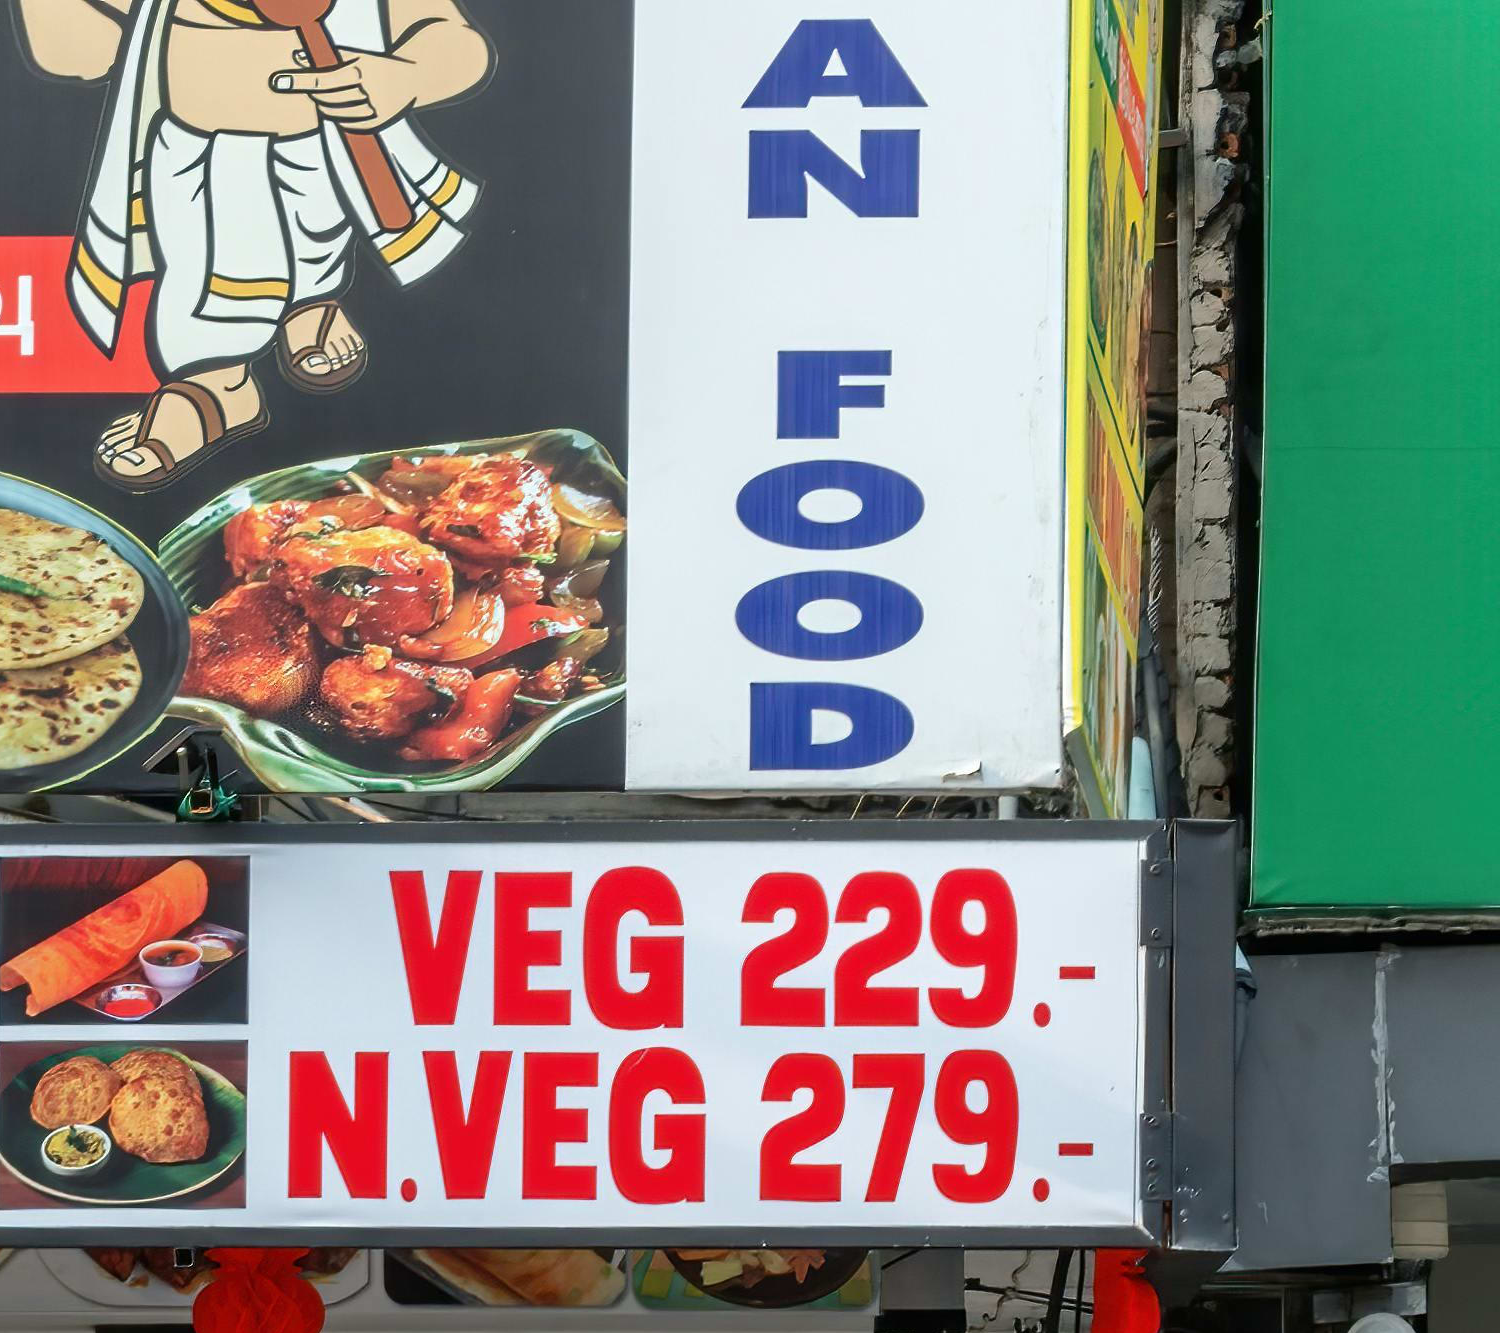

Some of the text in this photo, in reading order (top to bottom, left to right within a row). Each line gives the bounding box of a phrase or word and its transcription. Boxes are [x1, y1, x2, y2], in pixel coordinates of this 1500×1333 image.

[735, 350, 924, 772] FOOD
[388, 866, 1095, 1030] VEG 229.-
[287, 1046, 1093, 1204] N.VEG 279.-
